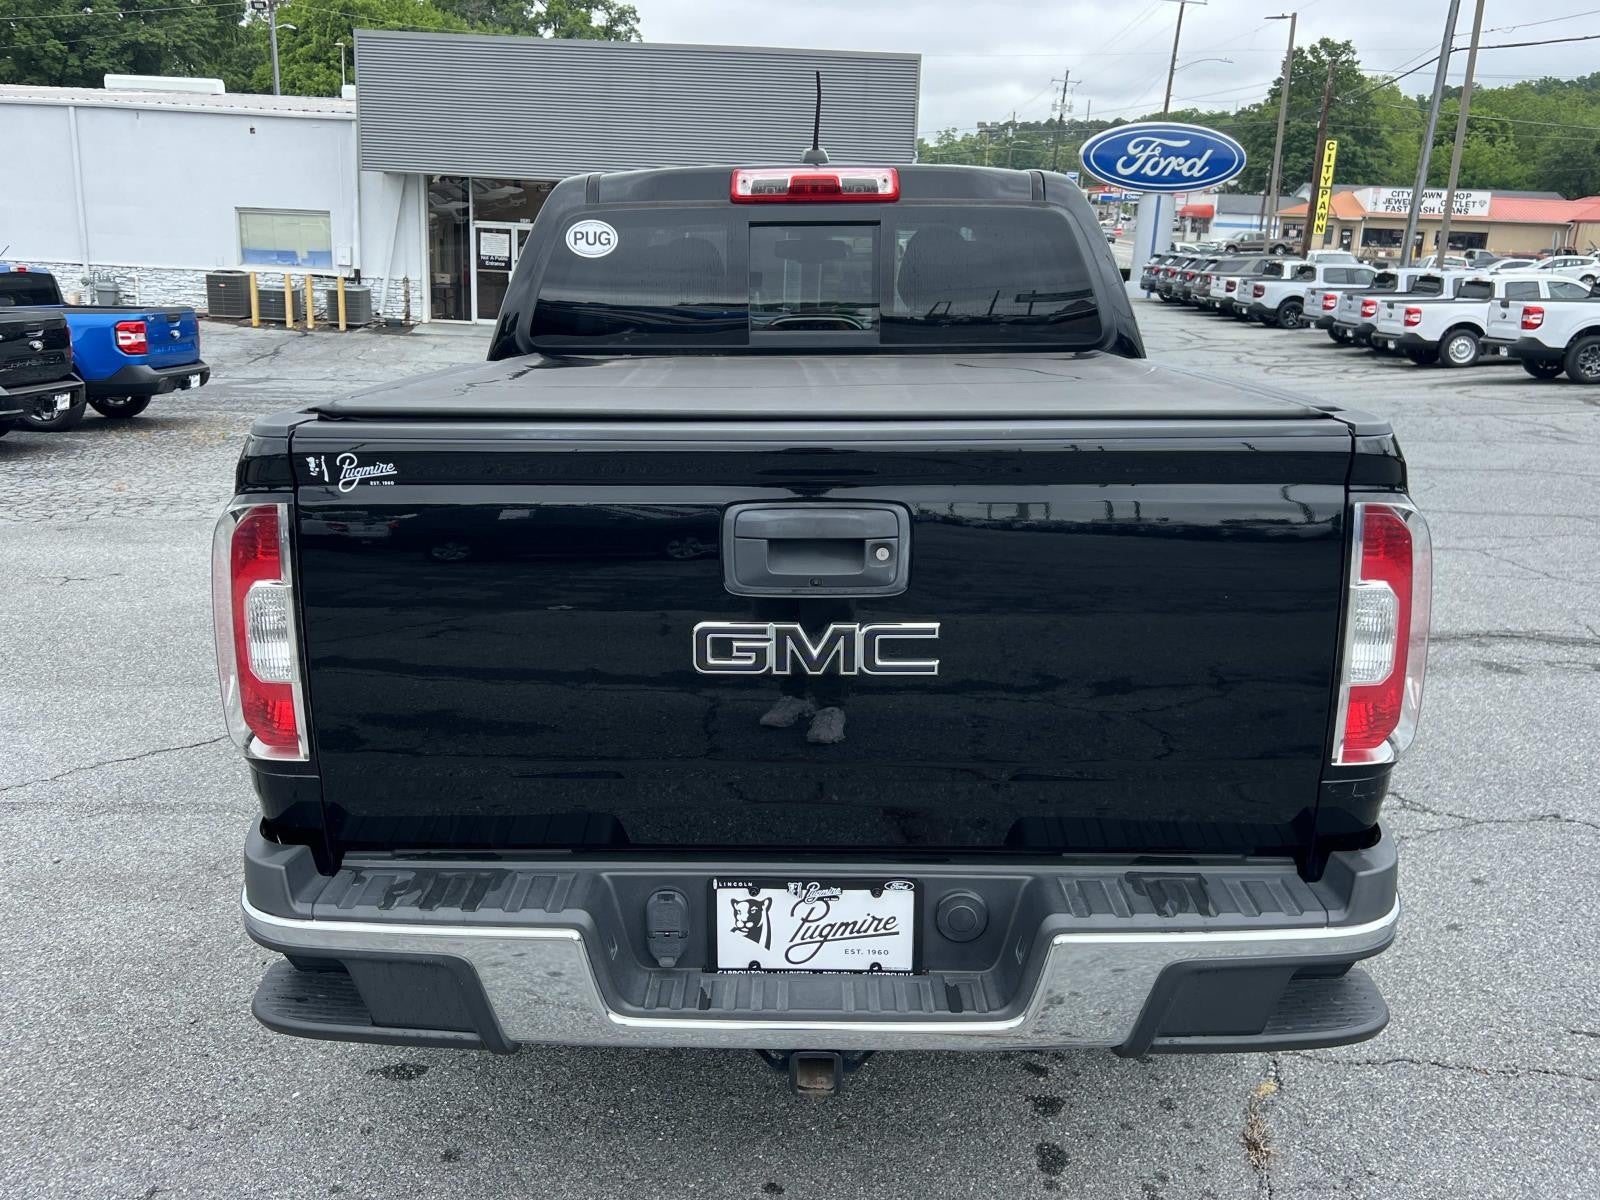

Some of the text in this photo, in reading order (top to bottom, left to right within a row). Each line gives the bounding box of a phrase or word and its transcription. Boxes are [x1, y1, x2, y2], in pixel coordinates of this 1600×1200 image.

[1116, 136, 1213, 177] Ford
[1315, 141, 1335, 233] CITY PAWN
[1391, 190, 1472, 200] CITY AWN HOP
[1382, 197, 1477, 208] JEWELY OTLET
[1385, 205, 1408, 213] FAST
[1438, 207, 1469, 215] LANS
[573, 230, 611, 246] PUG
[336, 452, 398, 493] Pugmire
[692, 621, 940, 676] GMC
[784, 896, 900, 965] Pugmire
[844, 948, 889, 957] EST. 1960
